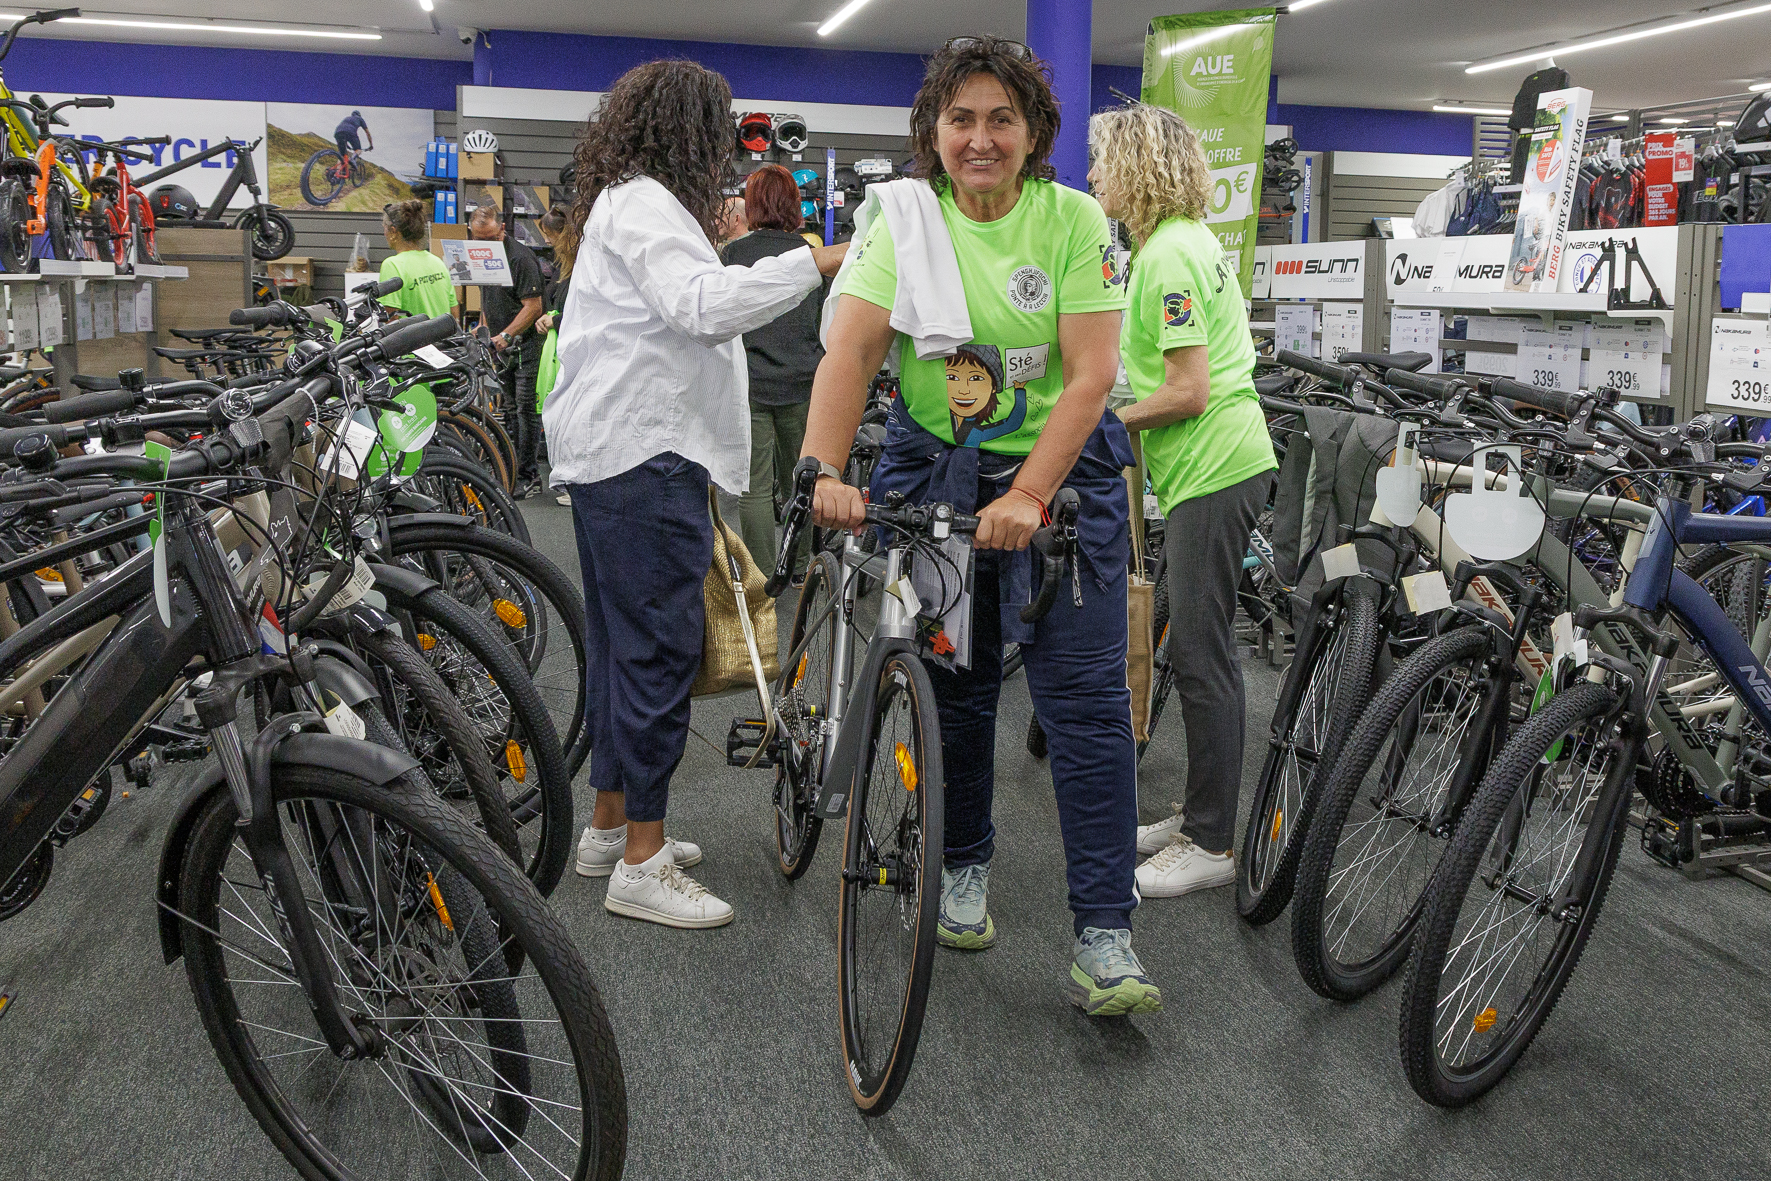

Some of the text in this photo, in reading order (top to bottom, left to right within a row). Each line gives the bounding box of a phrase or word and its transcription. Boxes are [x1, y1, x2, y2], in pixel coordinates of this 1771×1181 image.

[1189, 54, 1234, 76] AUE
[1197, 127, 1225, 143] 'AUE
[1571, 118, 1584, 157] FLAG
[1206, 147, 1242, 164] OFFRE
[1648, 149, 1674, 157] PROMO
[827, 156, 836, 201] INTERSPORT
[1303, 164, 1312, 206] INTERSPORT
[1548, 156, 1578, 280] BERG BIKY SAFETY
[1009, 352, 1033, 372] Sté
